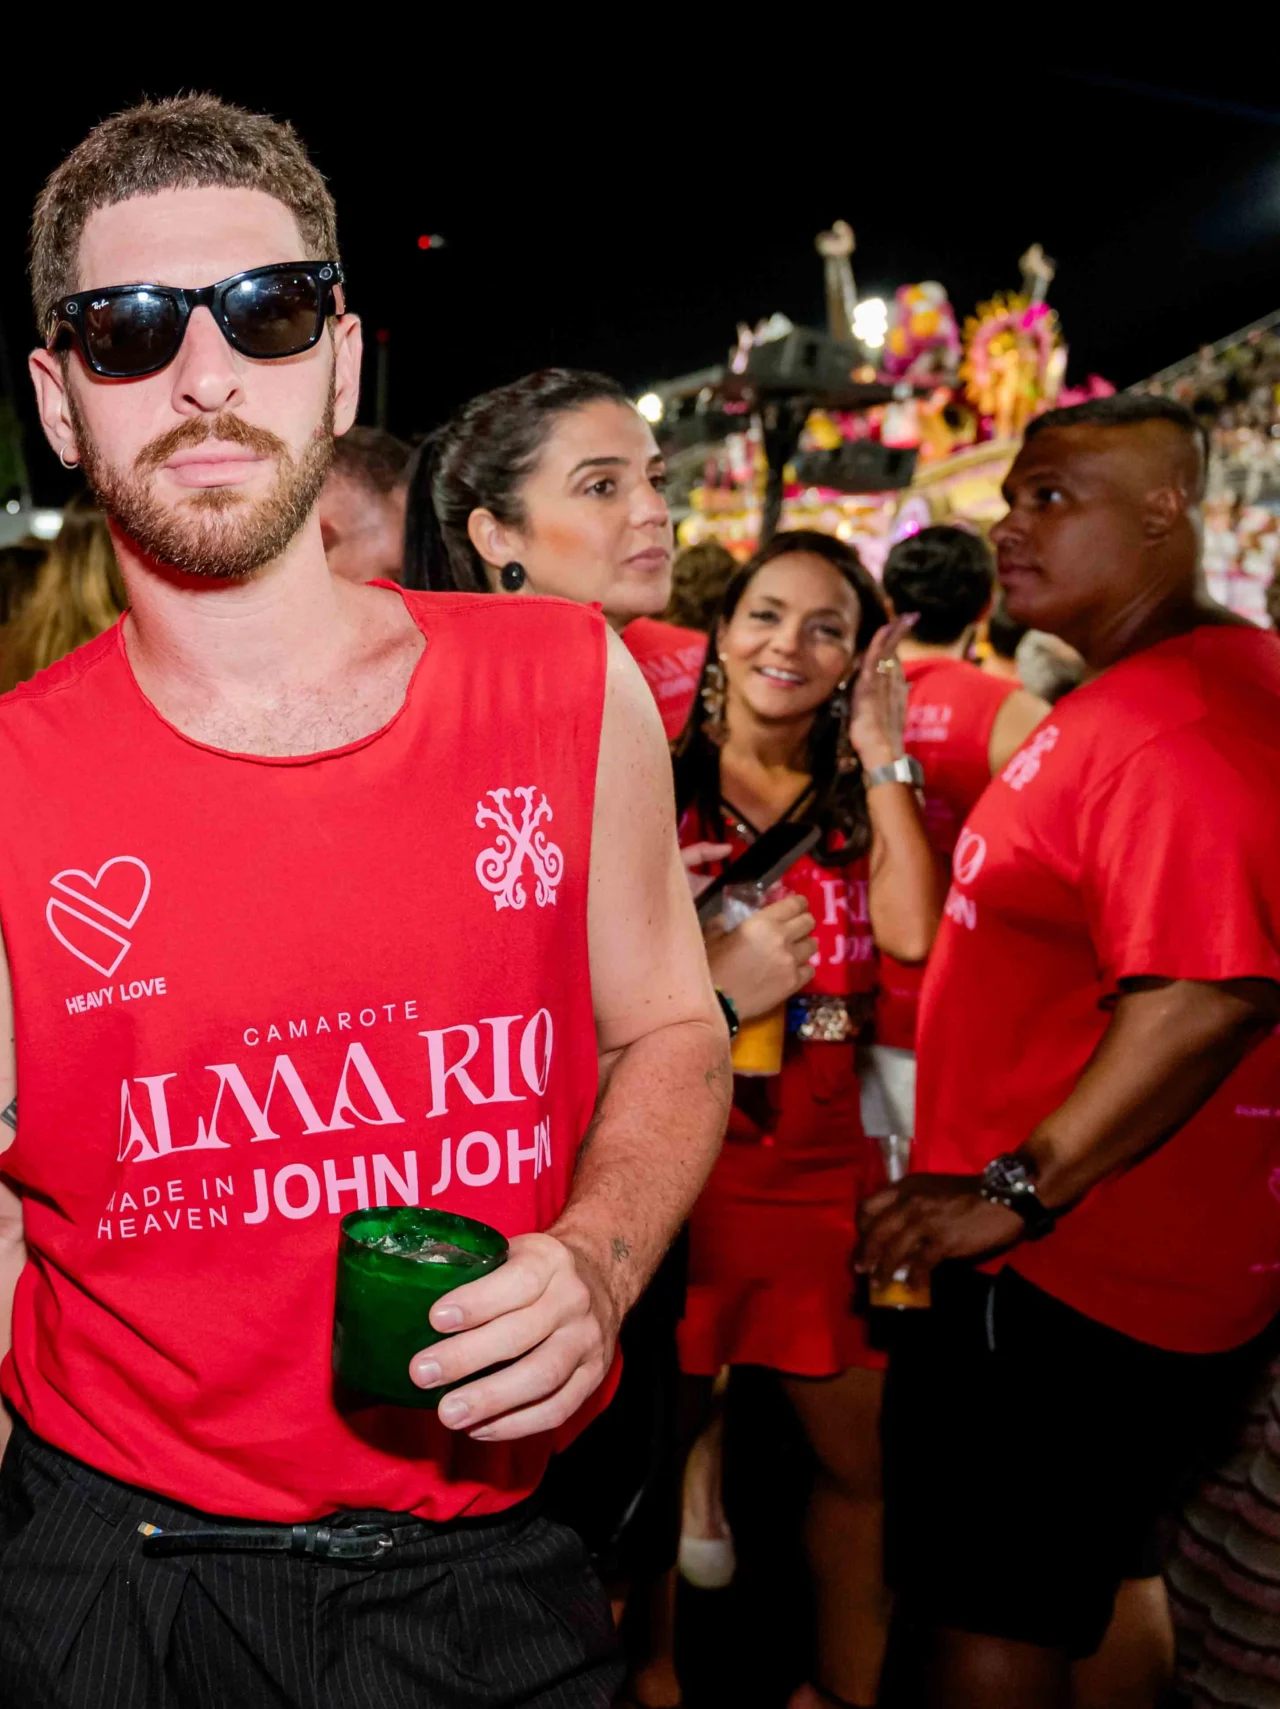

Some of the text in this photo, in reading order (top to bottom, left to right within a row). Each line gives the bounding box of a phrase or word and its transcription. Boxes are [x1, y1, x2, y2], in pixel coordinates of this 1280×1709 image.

[819, 879, 870, 926] RI
[65, 976, 167, 1015] HEAVY LOVE
[243, 1000, 419, 1047] CAMAROTE
[116, 1007, 553, 1163] ALMA RIO
[202, 1175, 234, 1200] IN
[243, 1150, 419, 1225] JOHN
[431, 1114, 552, 1195] JOHN
[97, 1205, 228, 1240] HEAVEN
